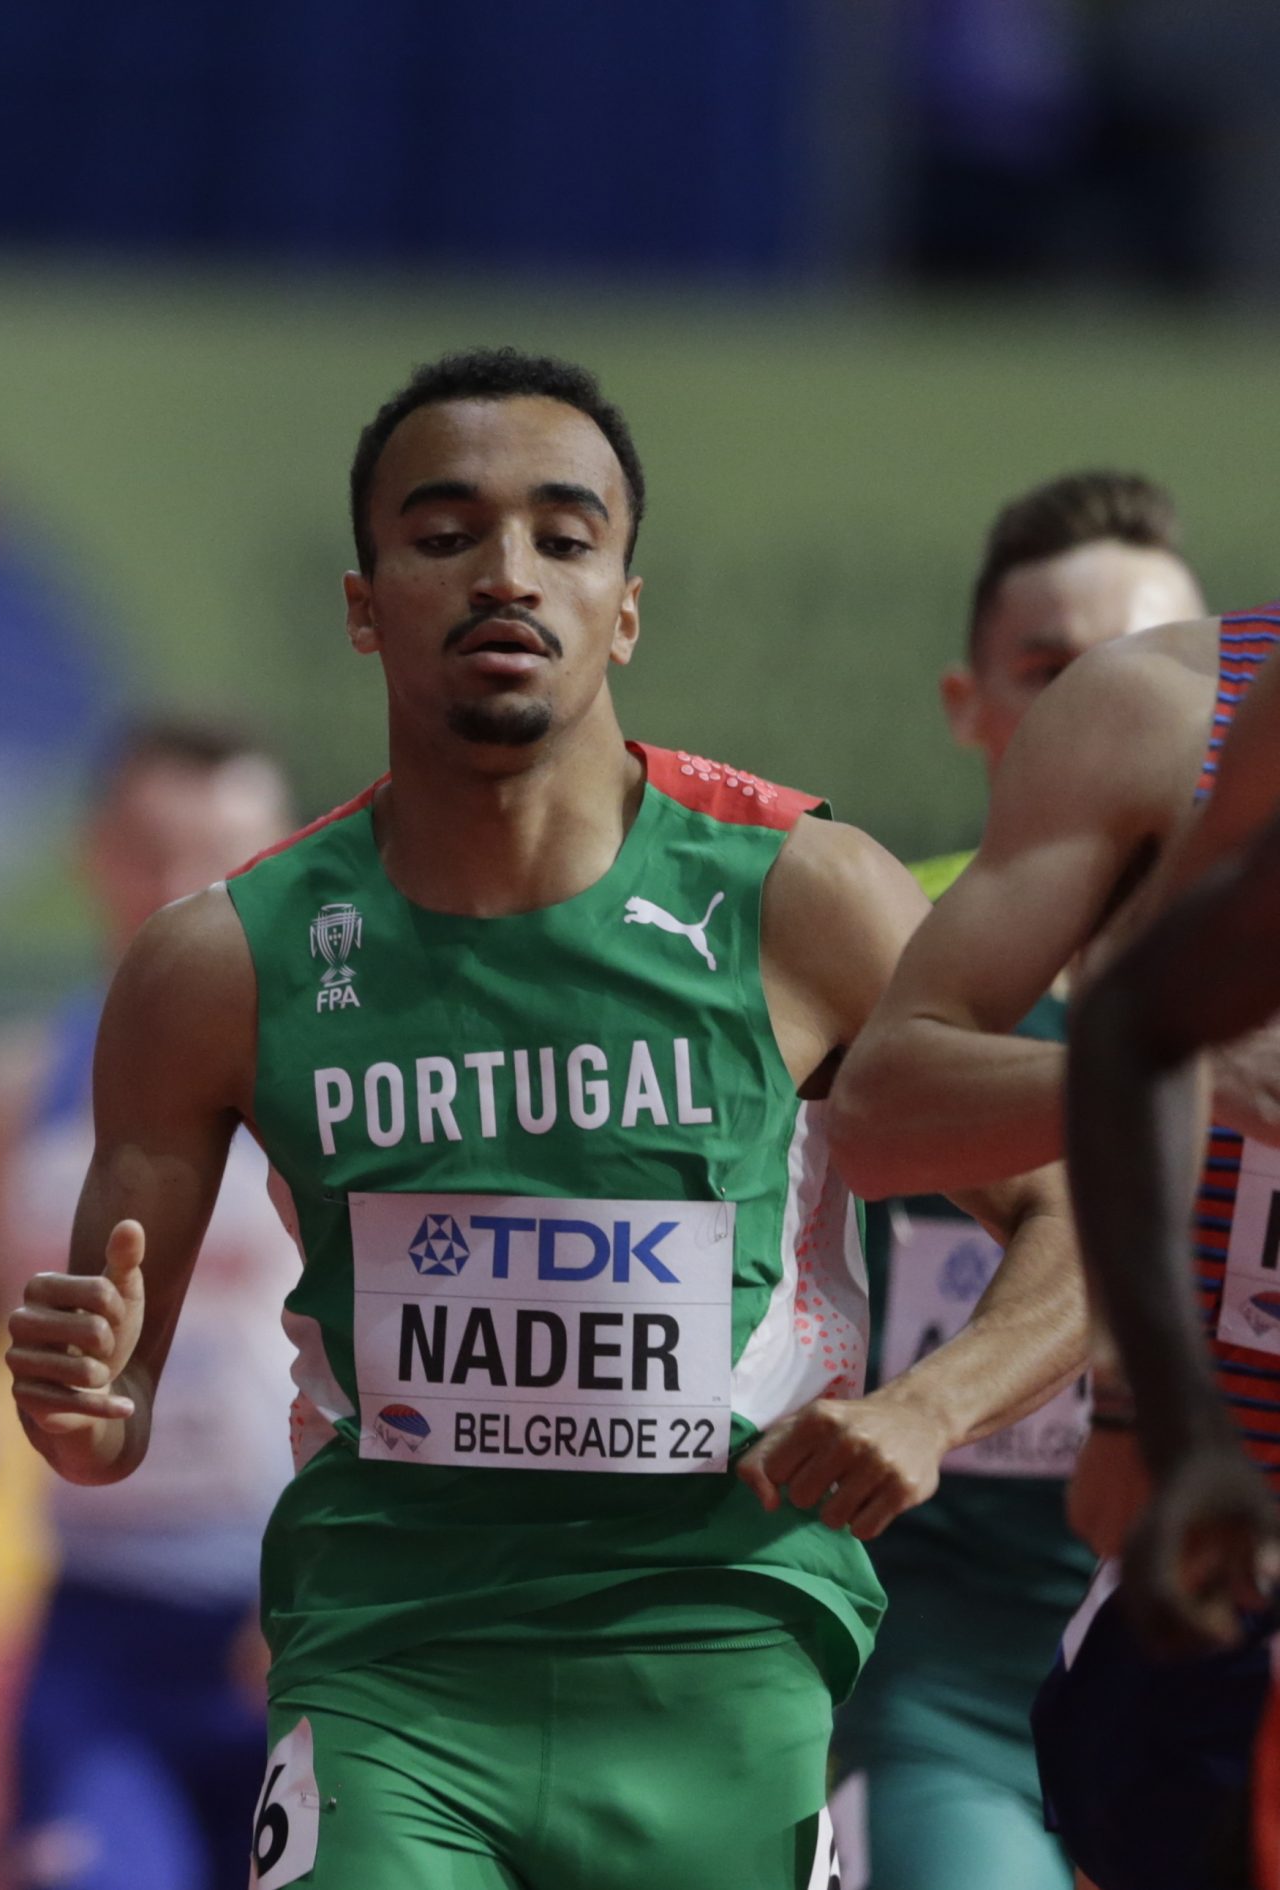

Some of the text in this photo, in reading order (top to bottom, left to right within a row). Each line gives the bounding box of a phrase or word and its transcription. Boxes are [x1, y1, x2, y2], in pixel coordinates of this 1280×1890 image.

[316, 985, 361, 1013] FPA
[314, 1038, 712, 1155] PORTUGAL
[470, 1216, 681, 1283] TDK
[397, 1303, 681, 1392] NADER
[454, 1412, 715, 1459] BELGRADE 22
[254, 1763, 289, 1880] 6
